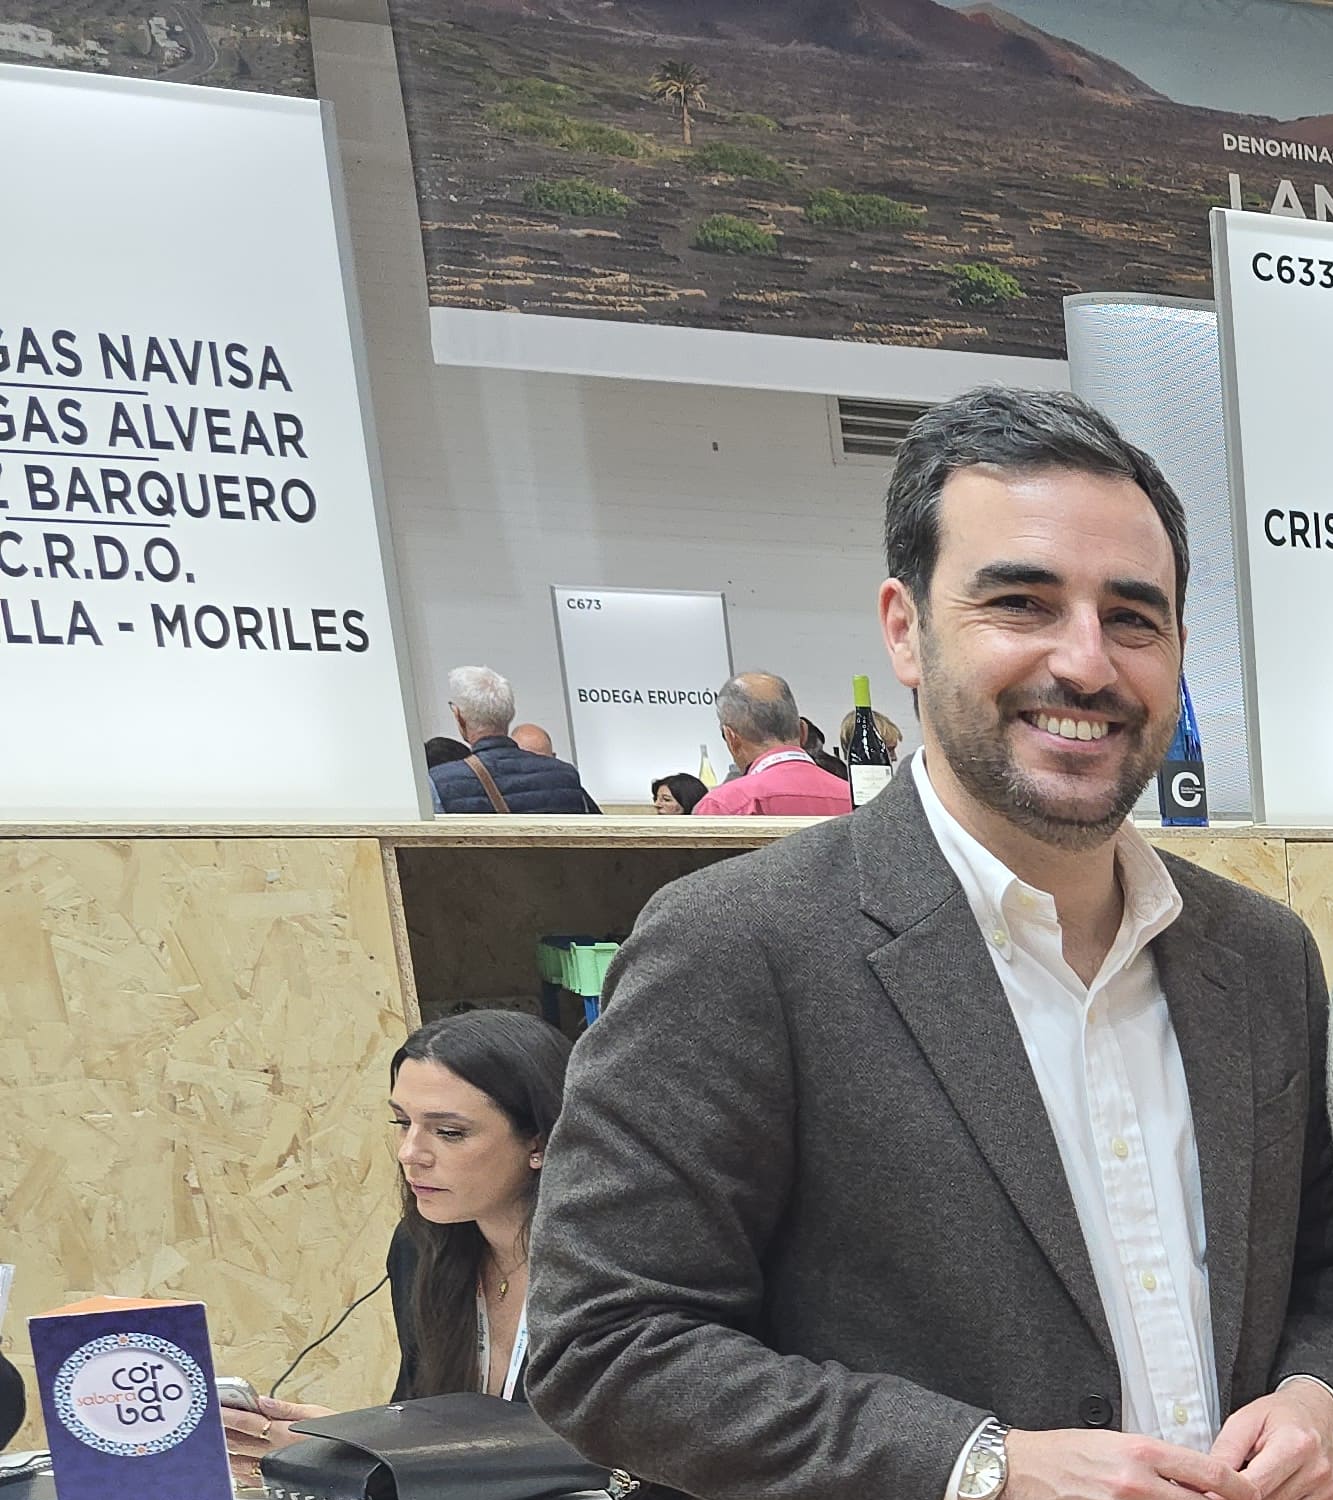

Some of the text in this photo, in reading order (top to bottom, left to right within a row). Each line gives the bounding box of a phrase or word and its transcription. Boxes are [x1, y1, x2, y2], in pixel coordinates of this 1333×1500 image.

[98, 332, 293, 393] NAVISA
[108, 401, 308, 458] ALVEAR
[24, 463, 317, 524] BARQUERO
[0, 530, 196, 584] C.R.D.O.
[150, 602, 370, 653] MORILES
[567, 598, 602, 610] C673
[577, 688, 643, 704] BODEGA
[1172, 771, 1202, 808] C
